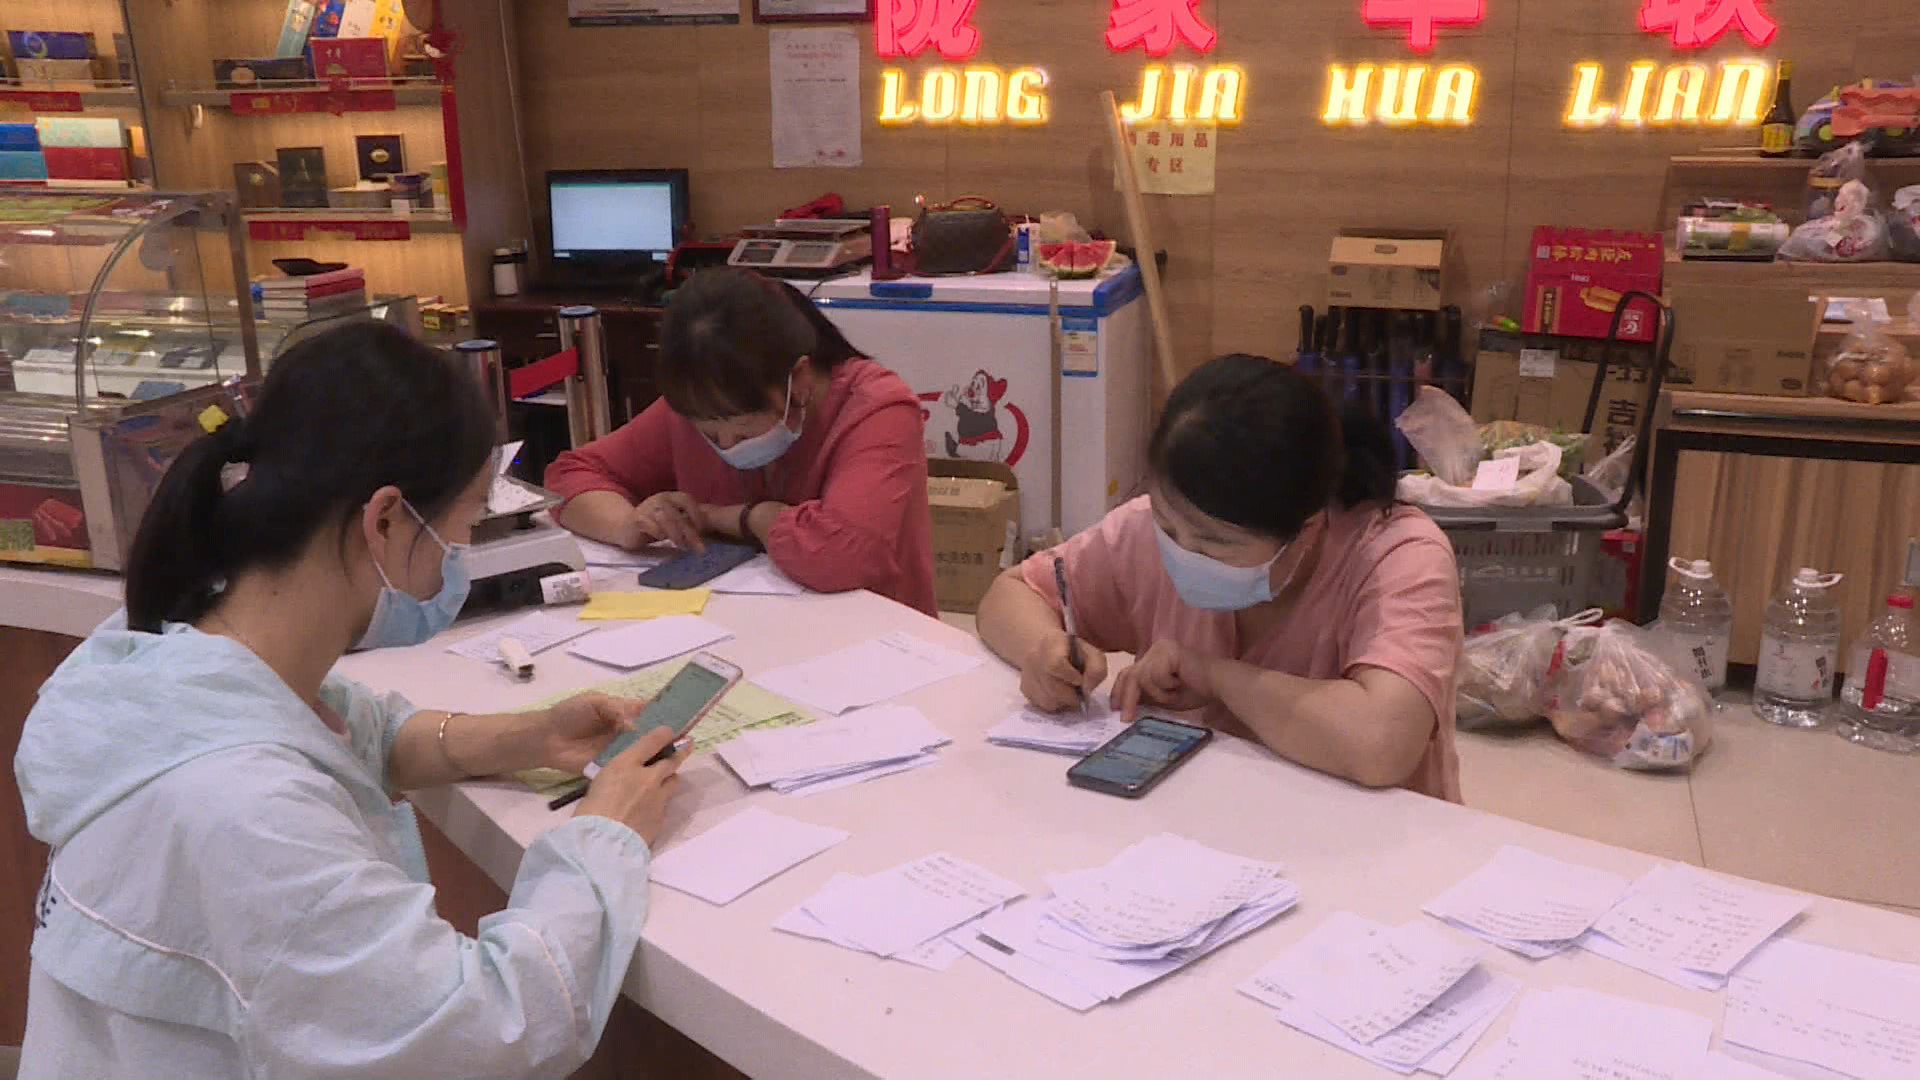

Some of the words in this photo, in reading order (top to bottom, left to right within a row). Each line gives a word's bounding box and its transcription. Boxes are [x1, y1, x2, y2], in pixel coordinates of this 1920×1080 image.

[880, 68, 1048, 123] LONG
[1119, 66, 1243, 122] JIA
[1322, 63, 1478, 123] HUA
[1565, 60, 1771, 124] LIAN
